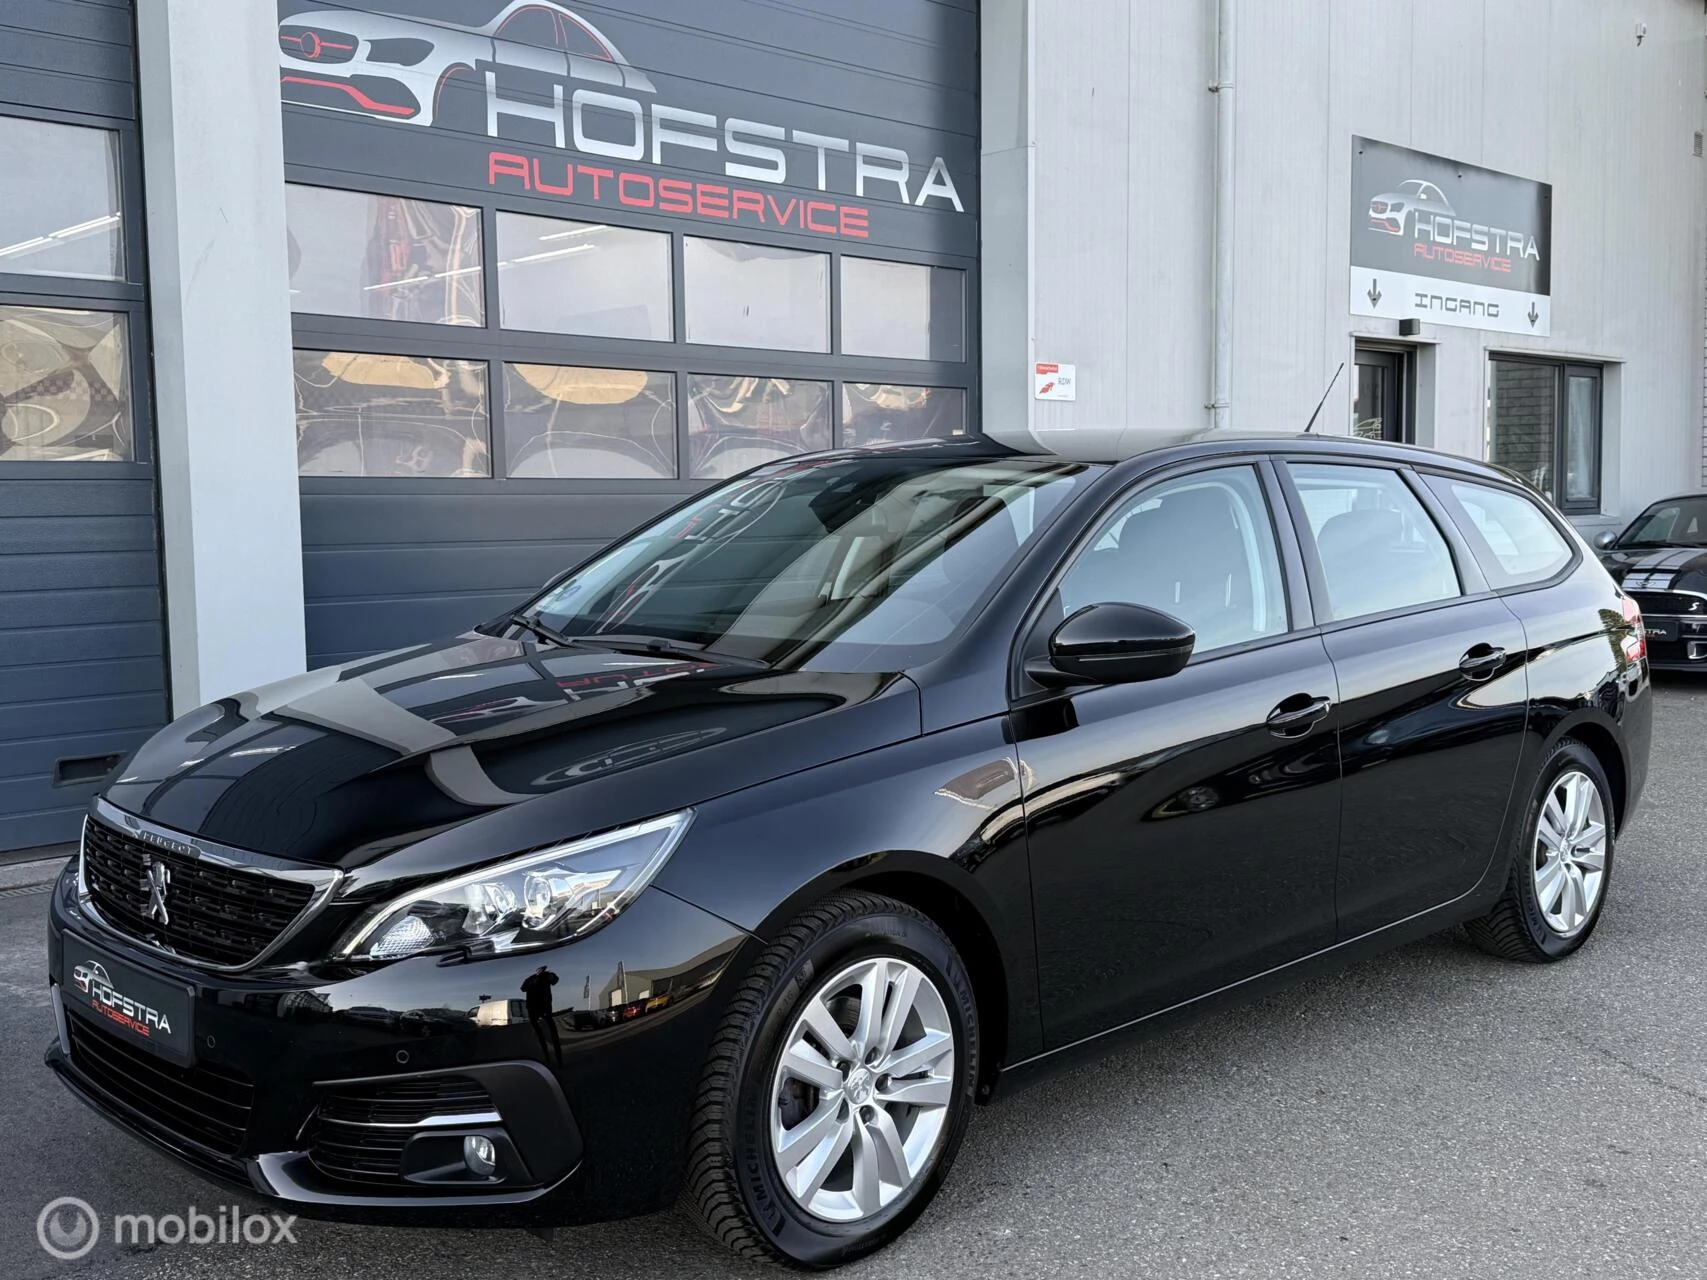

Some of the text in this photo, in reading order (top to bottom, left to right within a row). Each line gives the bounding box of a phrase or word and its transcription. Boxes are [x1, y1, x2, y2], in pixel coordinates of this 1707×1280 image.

[487, 71, 964, 212] HOFSTRA
[488, 152, 869, 238] AUTOSERVICE
[1413, 243, 1512, 273] AUTOSERVICE
[1414, 211, 1540, 261] HOFSTRA
[1414, 292, 1500, 318] INGANG
[91, 999, 151, 1037] AUTOSERVICE
[92, 980, 172, 1035] HOFSTRA
